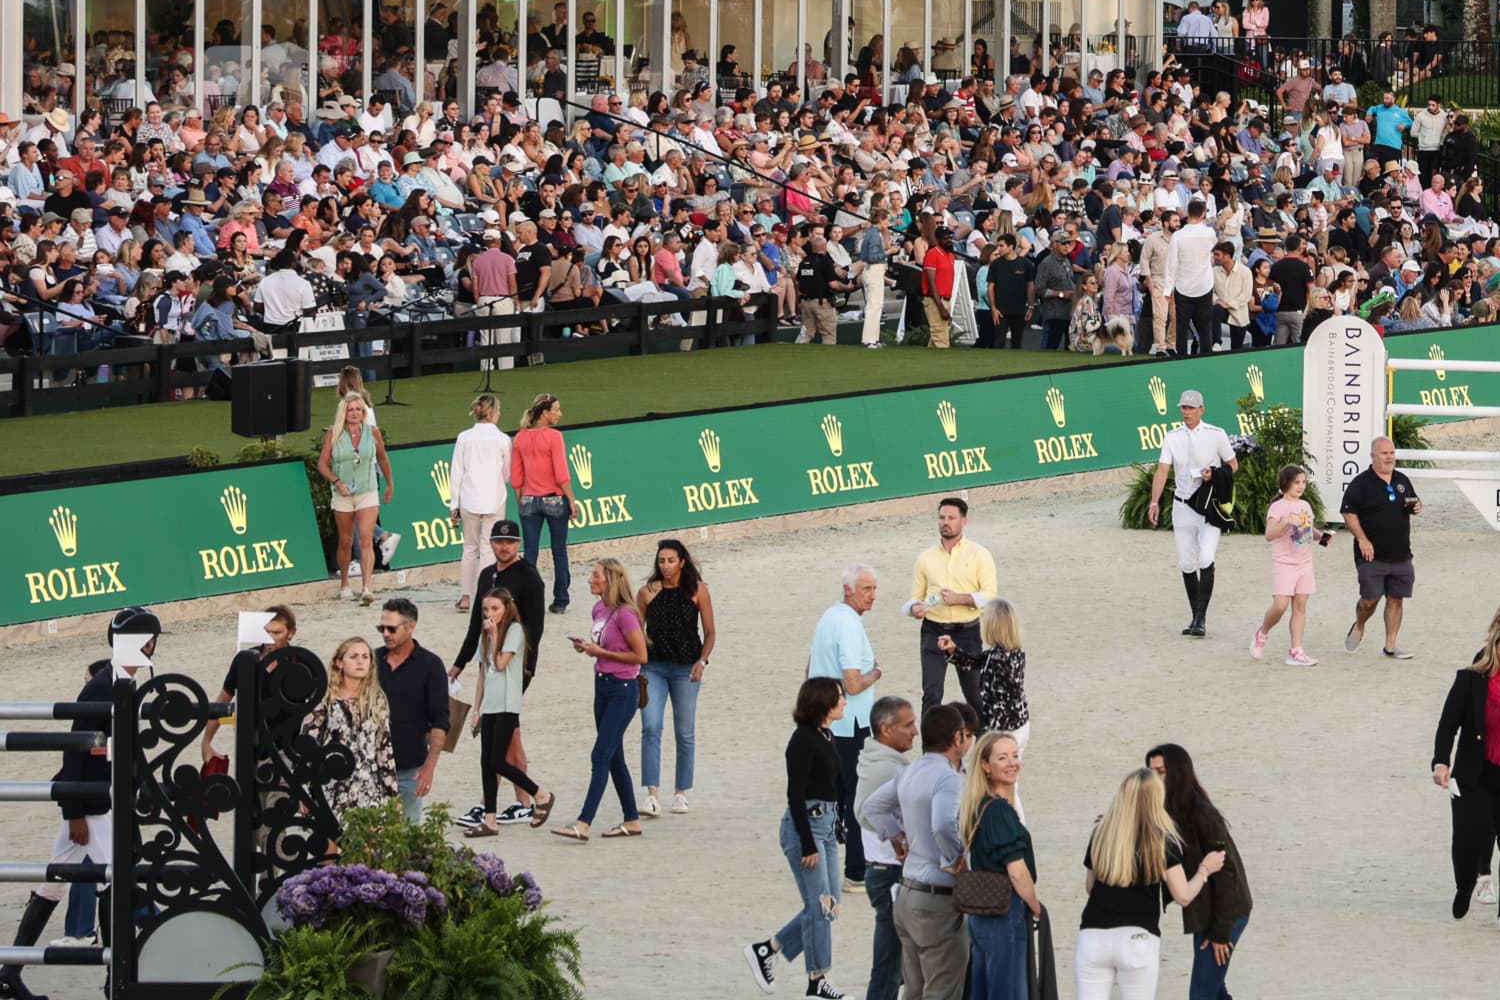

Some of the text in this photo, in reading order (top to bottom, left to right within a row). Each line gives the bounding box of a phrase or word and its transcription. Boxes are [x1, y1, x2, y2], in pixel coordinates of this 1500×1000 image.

[1420, 385, 1473, 408] ROLEX
[925, 446, 992, 479] ROLEX
[1034, 432, 1099, 464] ROLEX
[684, 477, 759, 513] ROLEX
[808, 461, 879, 495] ROLEX
[568, 494, 633, 529] OLEX
[412, 517, 464, 550] ROL
[199, 539, 294, 580] ROLEX
[26, 561, 127, 604] ROLEX
